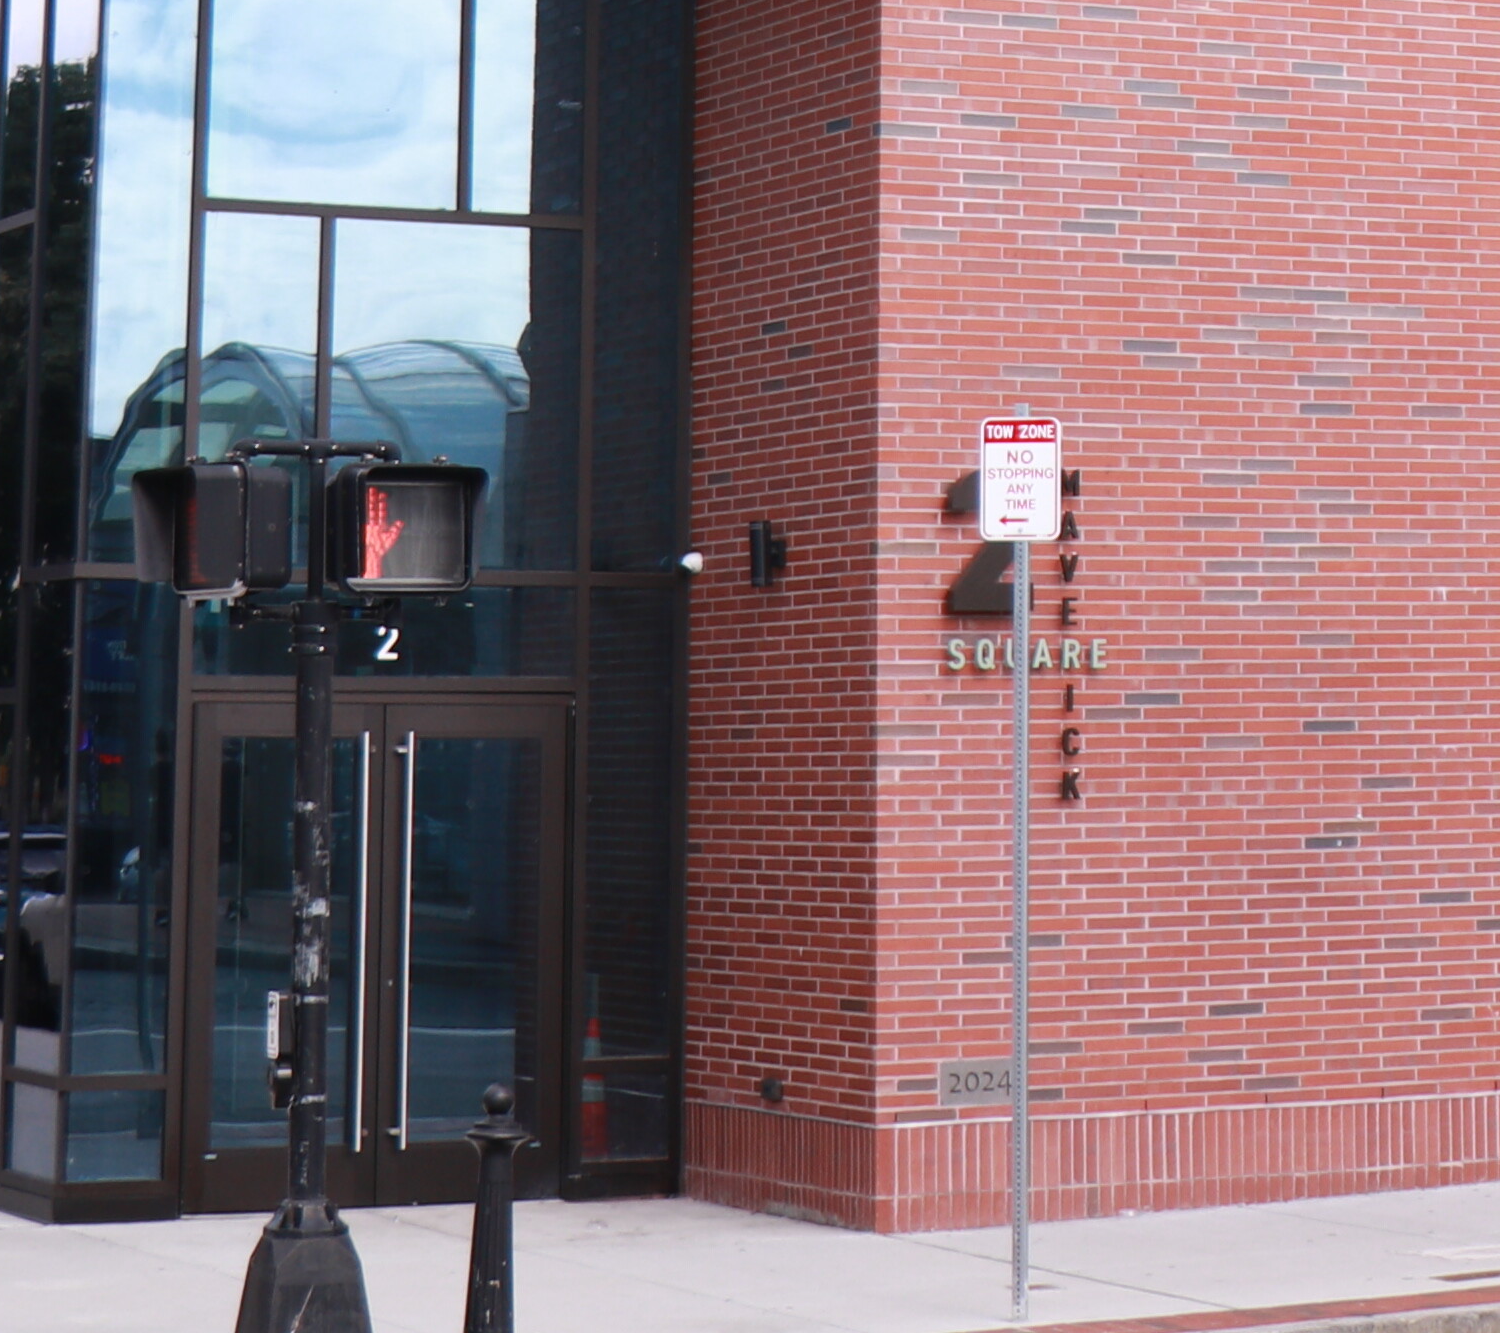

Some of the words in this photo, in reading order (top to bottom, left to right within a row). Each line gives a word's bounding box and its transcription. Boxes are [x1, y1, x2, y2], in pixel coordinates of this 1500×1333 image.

[986, 425, 1014, 439] TOW
[1018, 423, 1055, 439] ZONE
[1006, 450, 1034, 464] NO
[987, 468, 1054, 480] STOPPING
[1006, 484, 1033, 494] ANY
[1005, 499, 1036, 509] TIME
[377, 625, 399, 661] 2
[949, 1070, 1012, 1096] 2024
